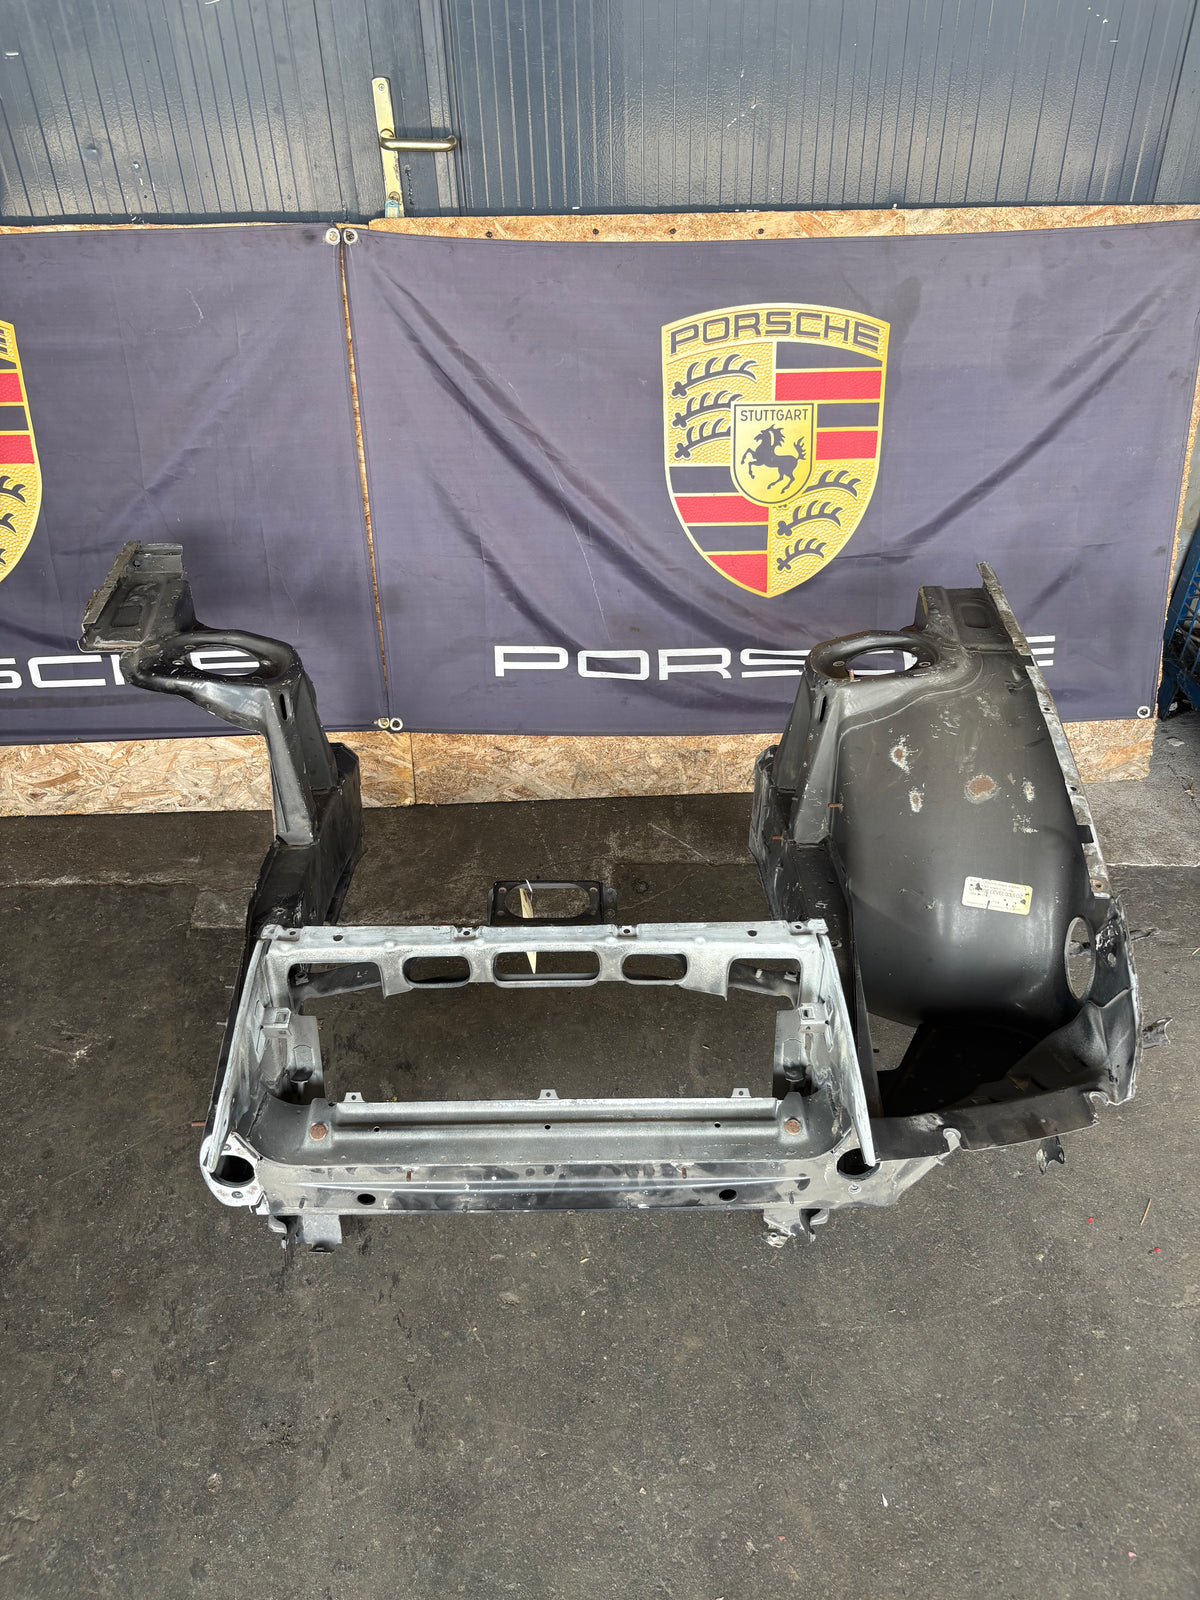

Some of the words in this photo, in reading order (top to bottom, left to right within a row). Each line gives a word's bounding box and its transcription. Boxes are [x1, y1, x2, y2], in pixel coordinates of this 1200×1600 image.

[670, 311, 880, 354] PORSCHE
[740, 408, 809, 422] STUTTGART
[494, 635, 1055, 681] PORS
